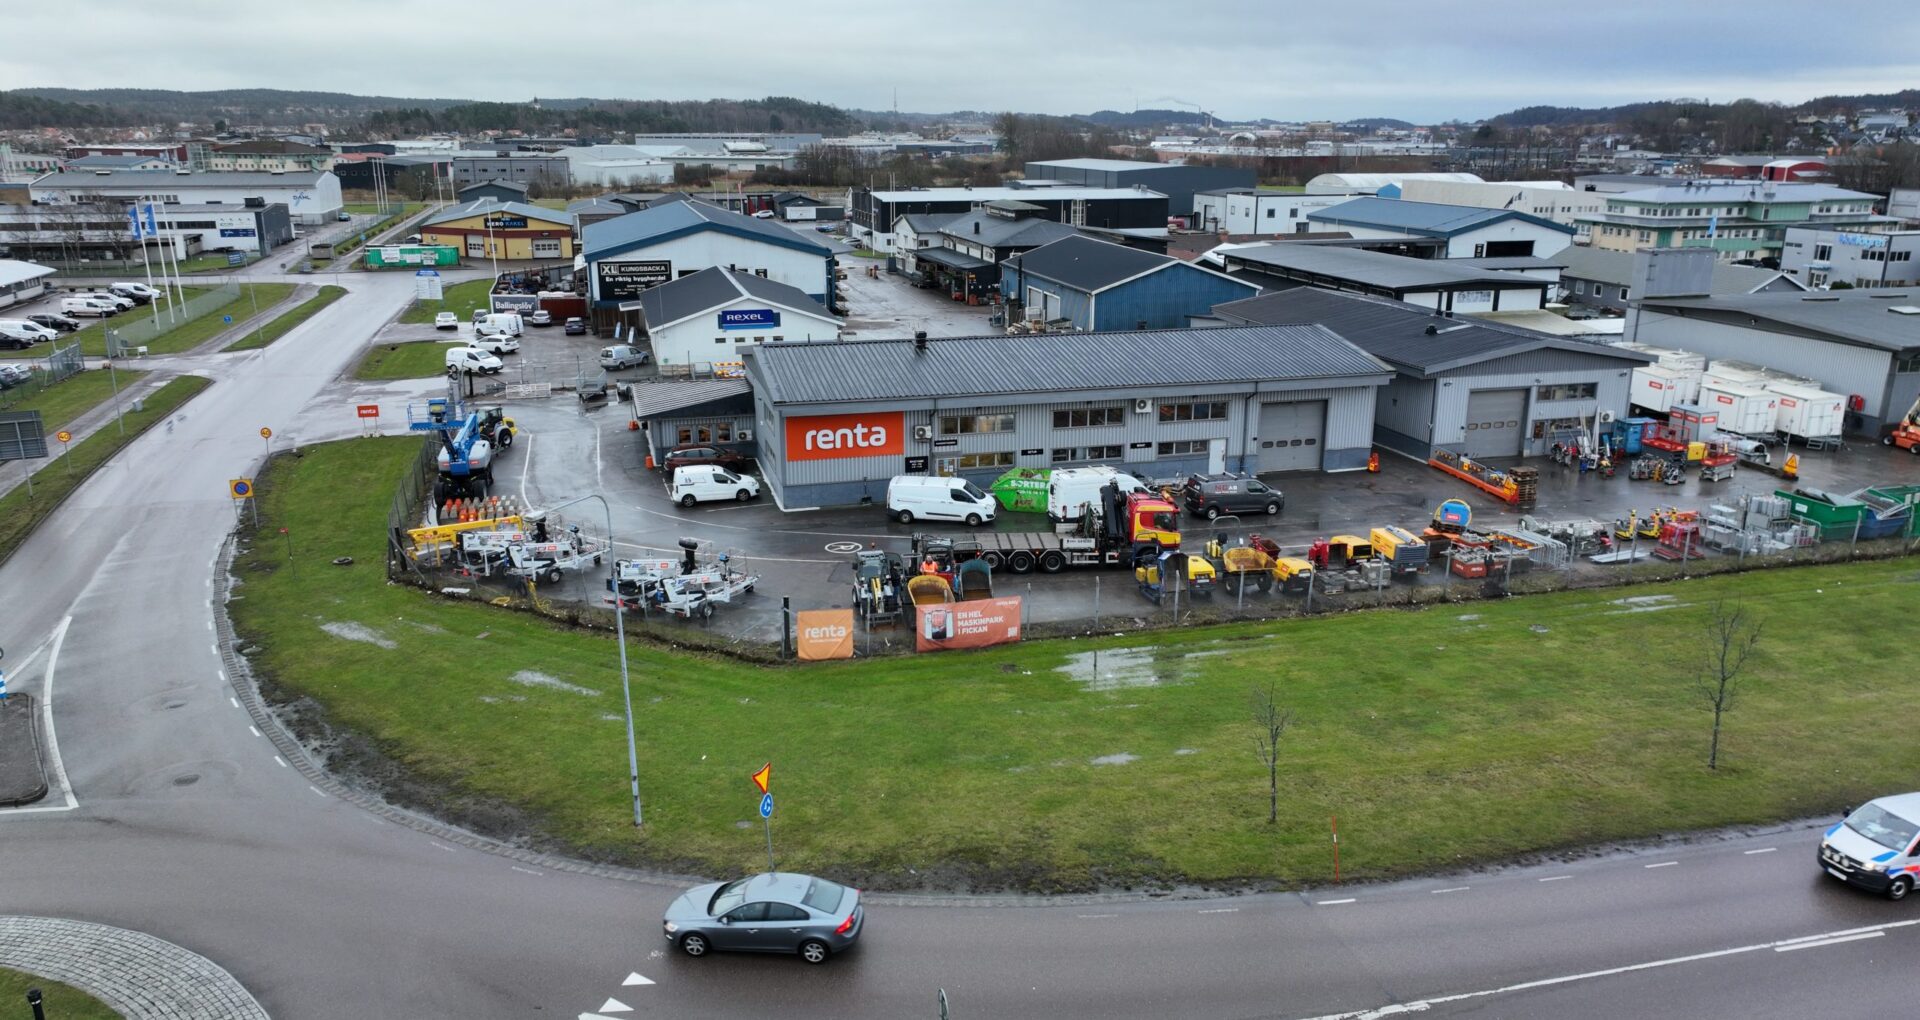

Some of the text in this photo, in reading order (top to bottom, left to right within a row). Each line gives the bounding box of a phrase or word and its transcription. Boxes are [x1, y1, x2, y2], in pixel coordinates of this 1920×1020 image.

[602, 265, 666, 275] XL KUNGSBACKA
[615, 275, 632, 283] riktig
[495, 301, 533, 311] Ballingslöv
[805, 423, 887, 451] renta
[957, 610, 983, 619] EN HEL
[957, 615, 1004, 627] MASKINPARK
[805, 624, 847, 640] renta
